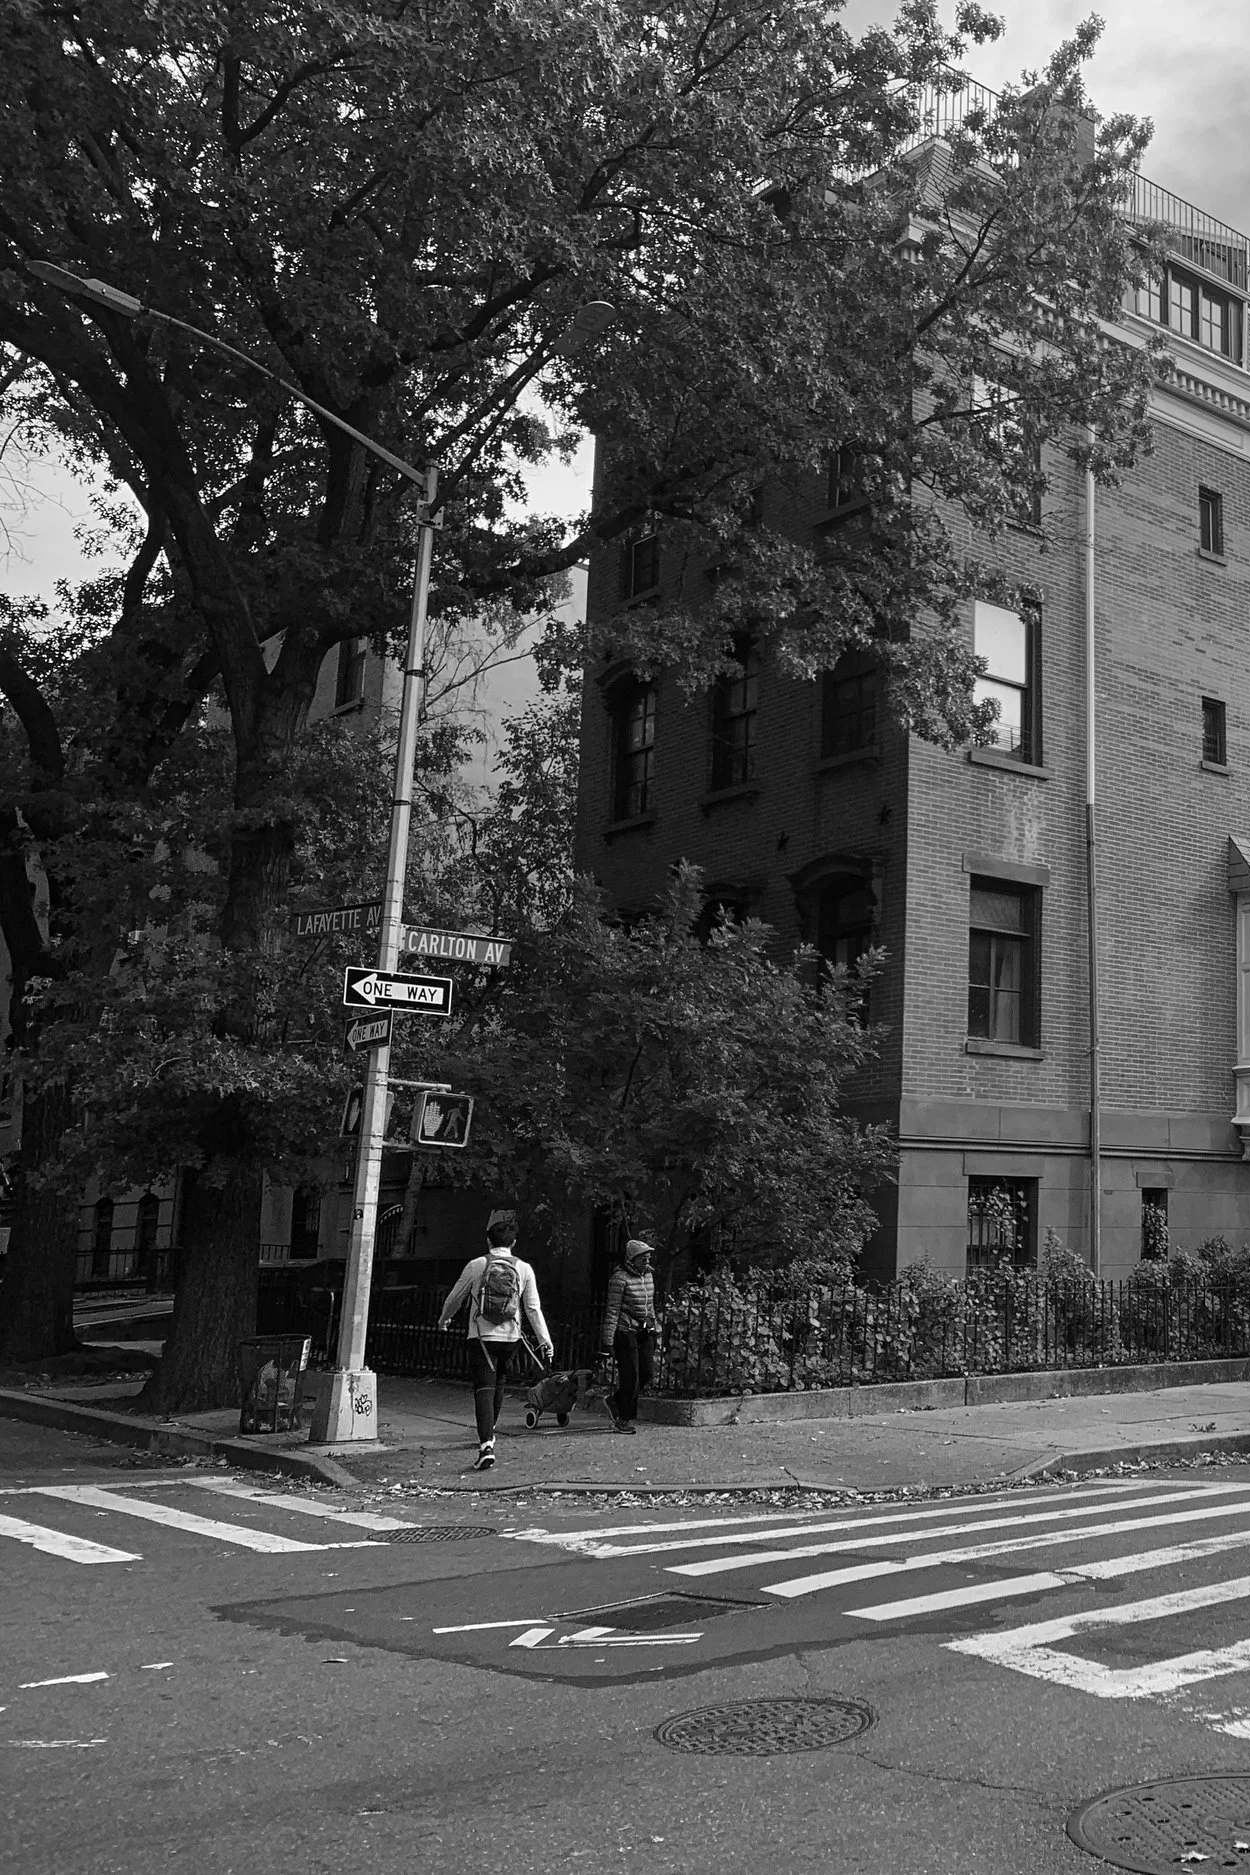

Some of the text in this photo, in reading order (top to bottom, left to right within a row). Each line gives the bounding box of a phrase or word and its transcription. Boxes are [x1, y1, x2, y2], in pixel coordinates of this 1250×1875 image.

[297, 905, 381, 935] LAFAYETTE AV
[408, 931, 477, 959] CARLTON
[484, 942, 505, 962] AV
[363, 981, 438, 1002] ONE WAY
[352, 1022, 385, 1042] ONE WAY
